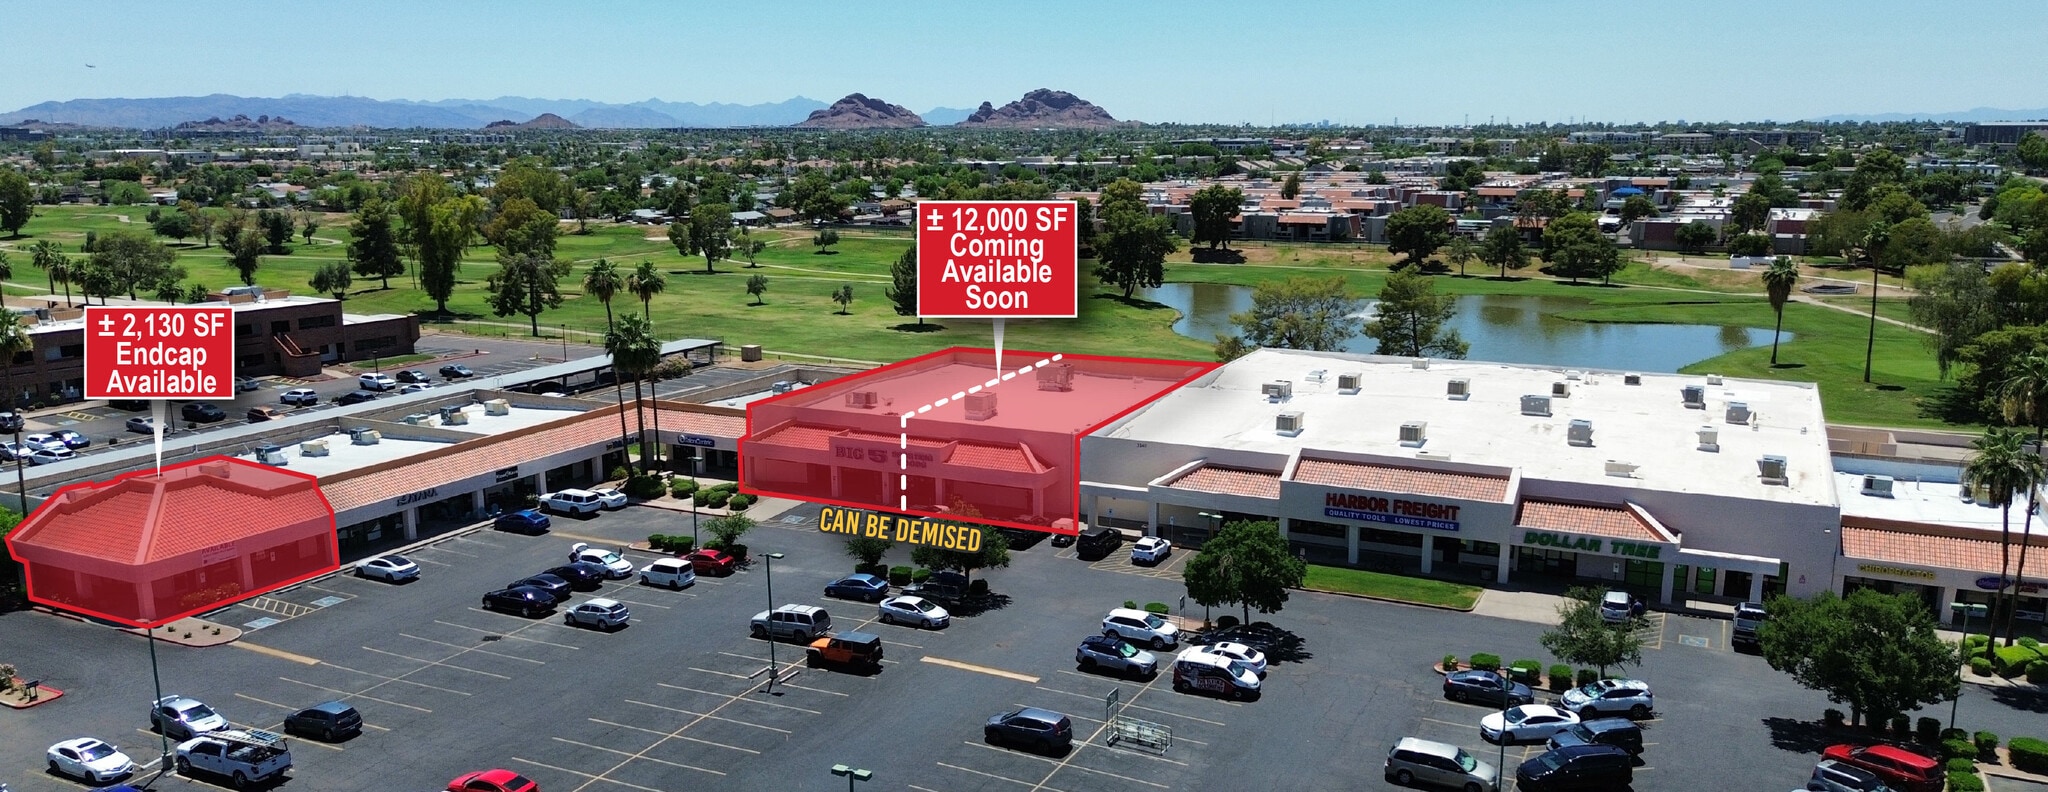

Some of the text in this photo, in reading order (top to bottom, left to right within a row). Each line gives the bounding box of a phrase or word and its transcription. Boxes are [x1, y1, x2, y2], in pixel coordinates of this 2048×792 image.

[835, 446, 888, 463] BIG 5
[1325, 492, 1461, 521] HARBOR FREIGHT
[1329, 509, 1455, 530] QUALITY TOOLS LOWEST PRICES
[1523, 531, 1661, 559] DOLLAR TREE
[1858, 564, 1936, 579] CHIROPRACTOR
